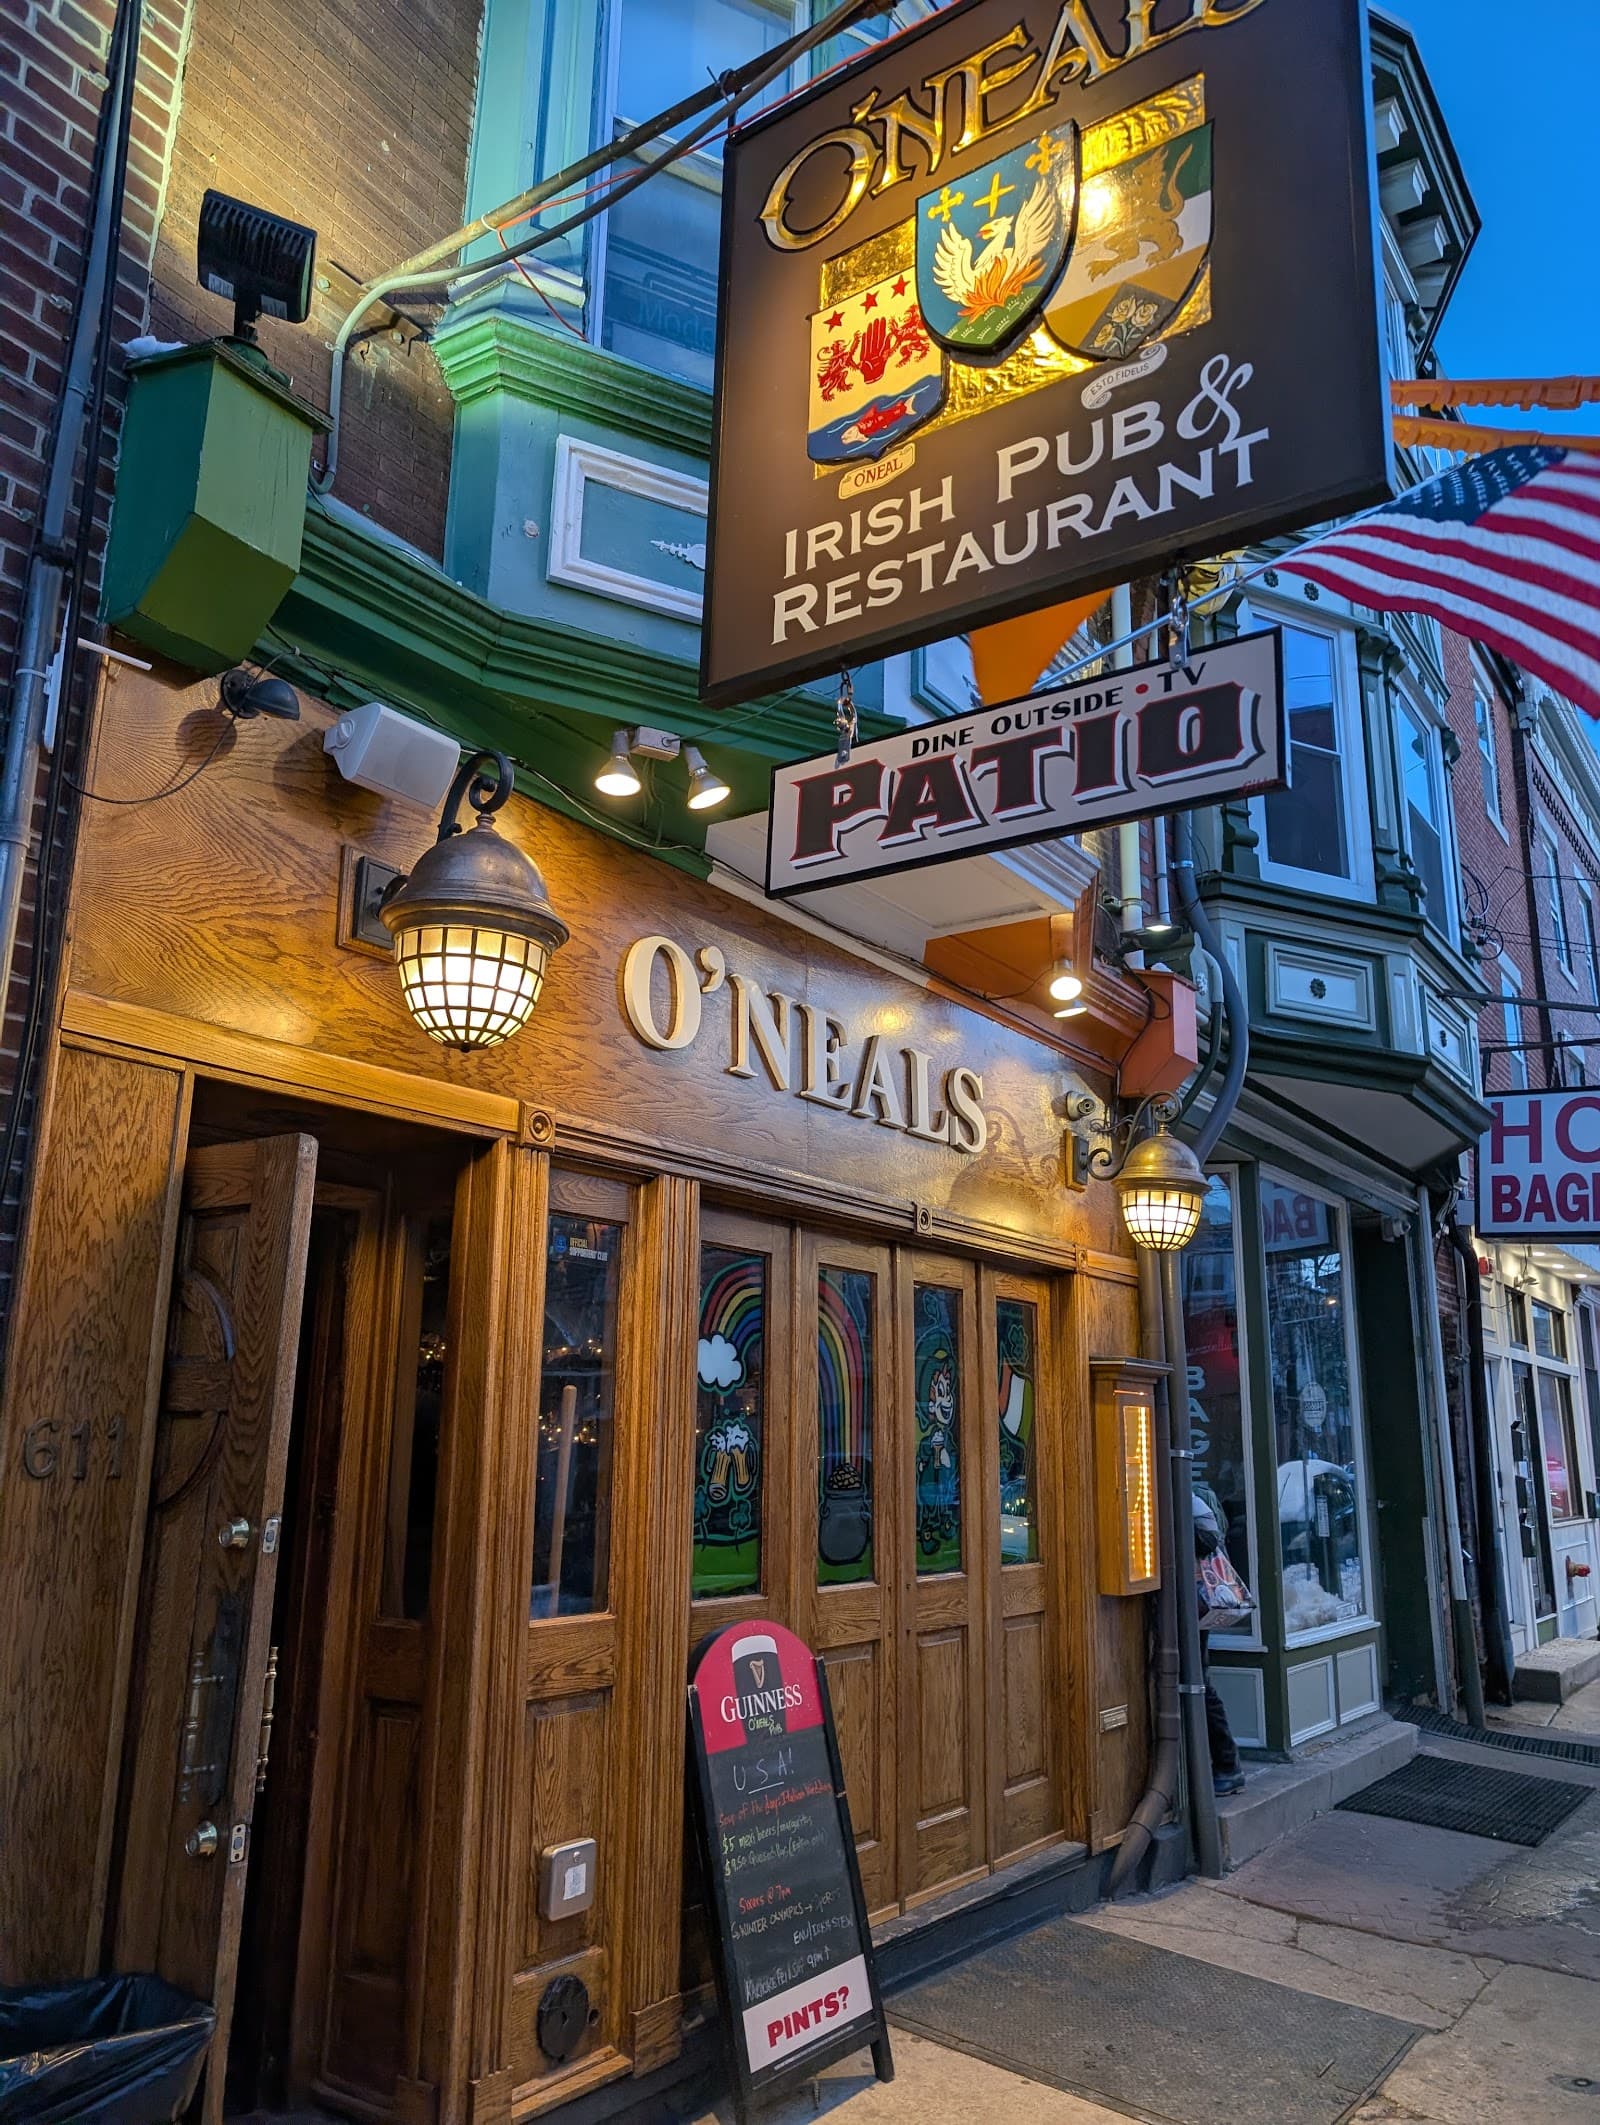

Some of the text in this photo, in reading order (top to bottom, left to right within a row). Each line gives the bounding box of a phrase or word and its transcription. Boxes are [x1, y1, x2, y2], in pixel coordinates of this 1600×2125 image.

[761, 0, 1265, 249] O'NEAL
[1089, 361, 1150, 396] ESTO FIDELIS
[783, 353, 1254, 579] IRISH PUB &
[854, 458, 904, 488] O'NEAL
[770, 427, 1270, 646] RESTAURANT
[912, 661, 1206, 758] DINE OUTSIDE TV
[788, 681, 1266, 871] PATIO
[624, 935, 987, 1153] O'NEALS
[24, 1416, 124, 1480] 611
[721, 1684, 803, 1723] GUINNESS
[739, 1915, 769, 1938] WINTER
[767, 1986, 849, 2048] PINTS?
